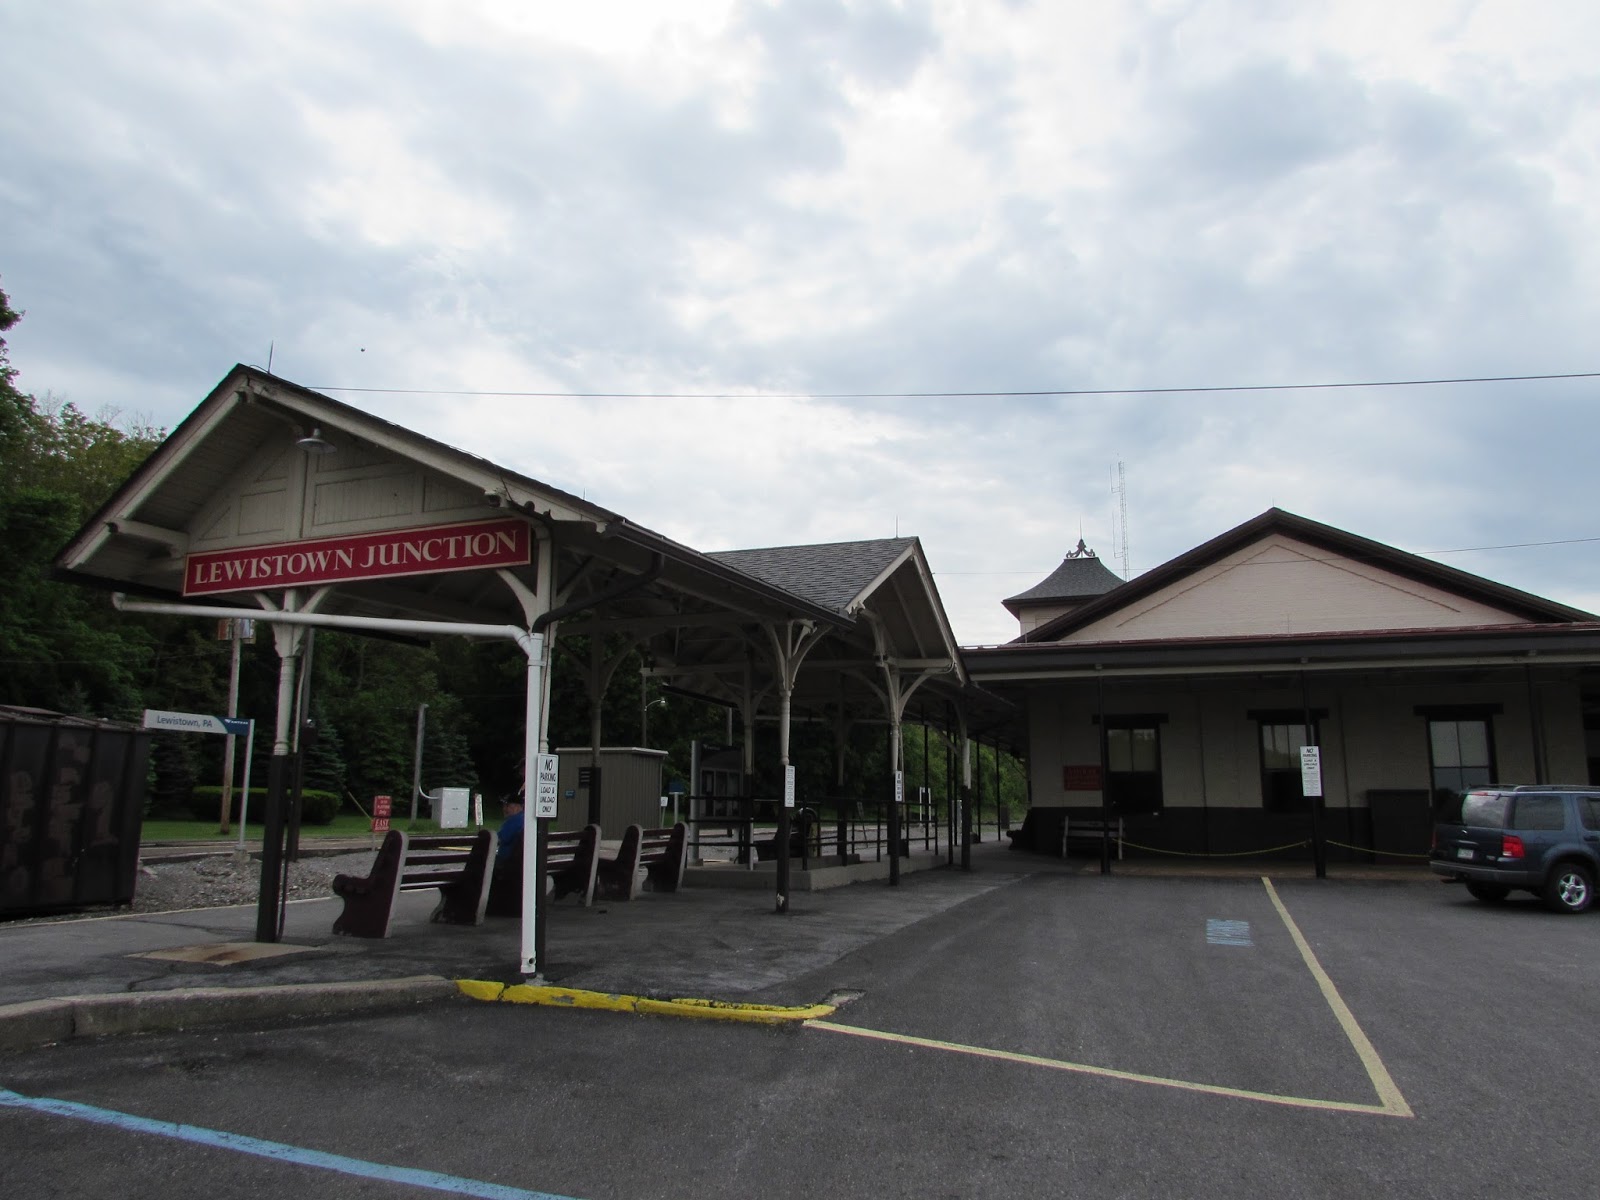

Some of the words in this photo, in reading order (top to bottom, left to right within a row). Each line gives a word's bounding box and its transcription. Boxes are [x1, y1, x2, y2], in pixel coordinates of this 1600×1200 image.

[194, 547, 355, 584] LEWISTOWN
[359, 530, 519, 568] JUNCTION
[157, 715, 200, 728] Lewistown,
[202, 719, 213, 728] PA
[545, 759, 554, 771] NO
[540, 772, 556, 782] PARKING
[540, 786, 551, 794] LOAD
[542, 805, 552, 813] ONLY
